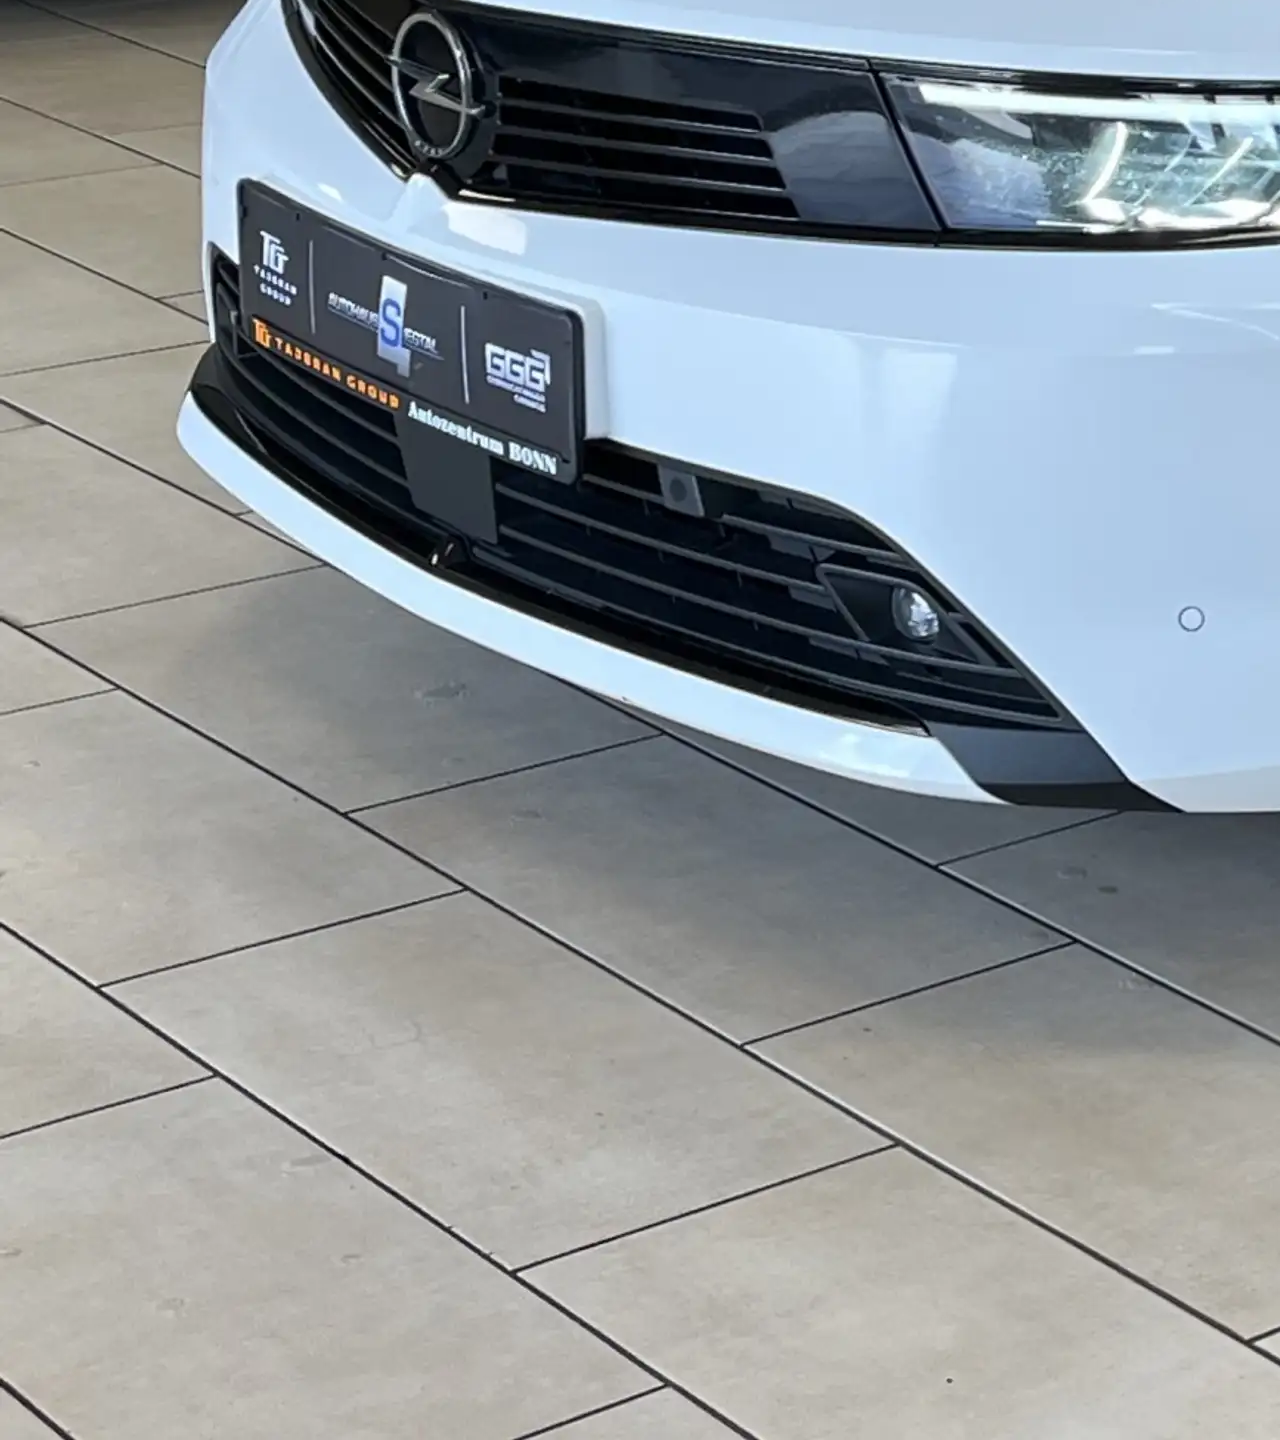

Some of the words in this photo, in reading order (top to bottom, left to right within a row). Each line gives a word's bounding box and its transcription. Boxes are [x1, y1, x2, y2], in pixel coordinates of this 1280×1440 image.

[346, 374, 400, 409] GROUP
[408, 401, 505, 456] Autozentrum
[508, 441, 557, 475] BONN
